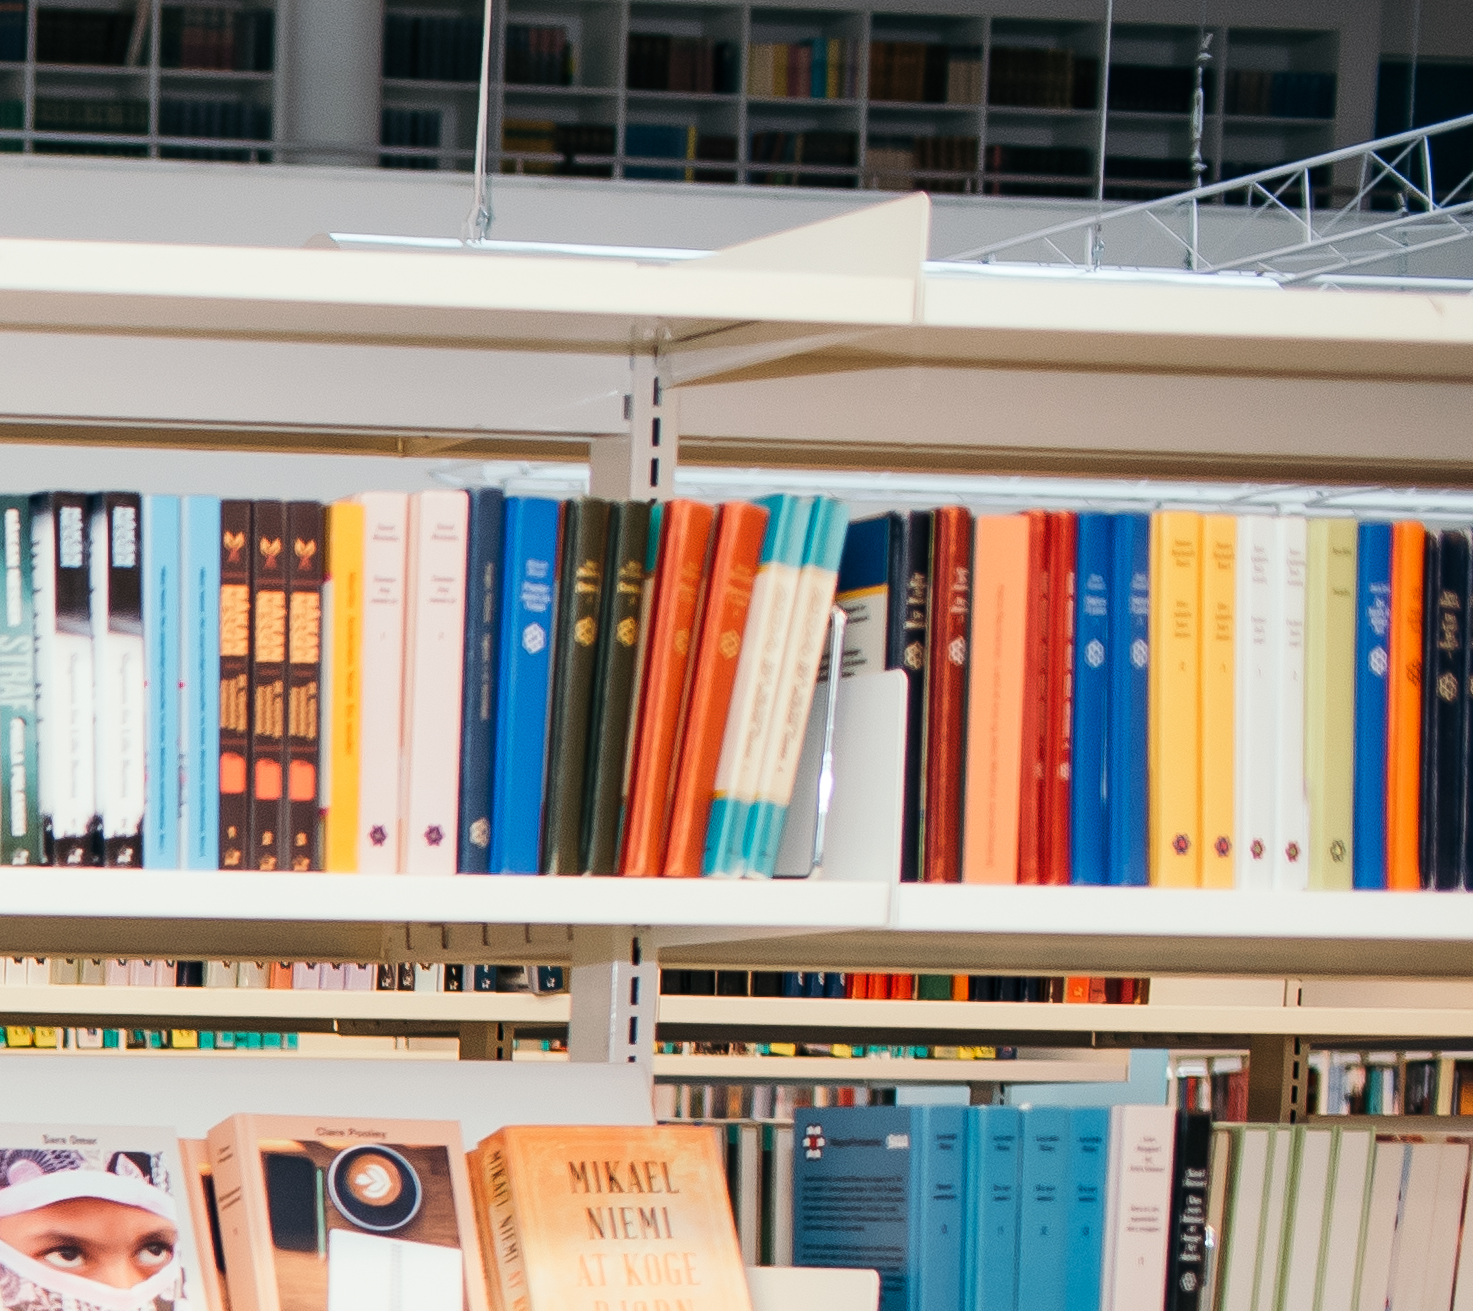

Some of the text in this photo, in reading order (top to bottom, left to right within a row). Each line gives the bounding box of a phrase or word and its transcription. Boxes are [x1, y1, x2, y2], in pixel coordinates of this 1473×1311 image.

[567, 1160, 681, 1195] MIKAEL
[586, 1206, 674, 1240] NIEMI
[576, 1252, 702, 1287] AT KOGE
